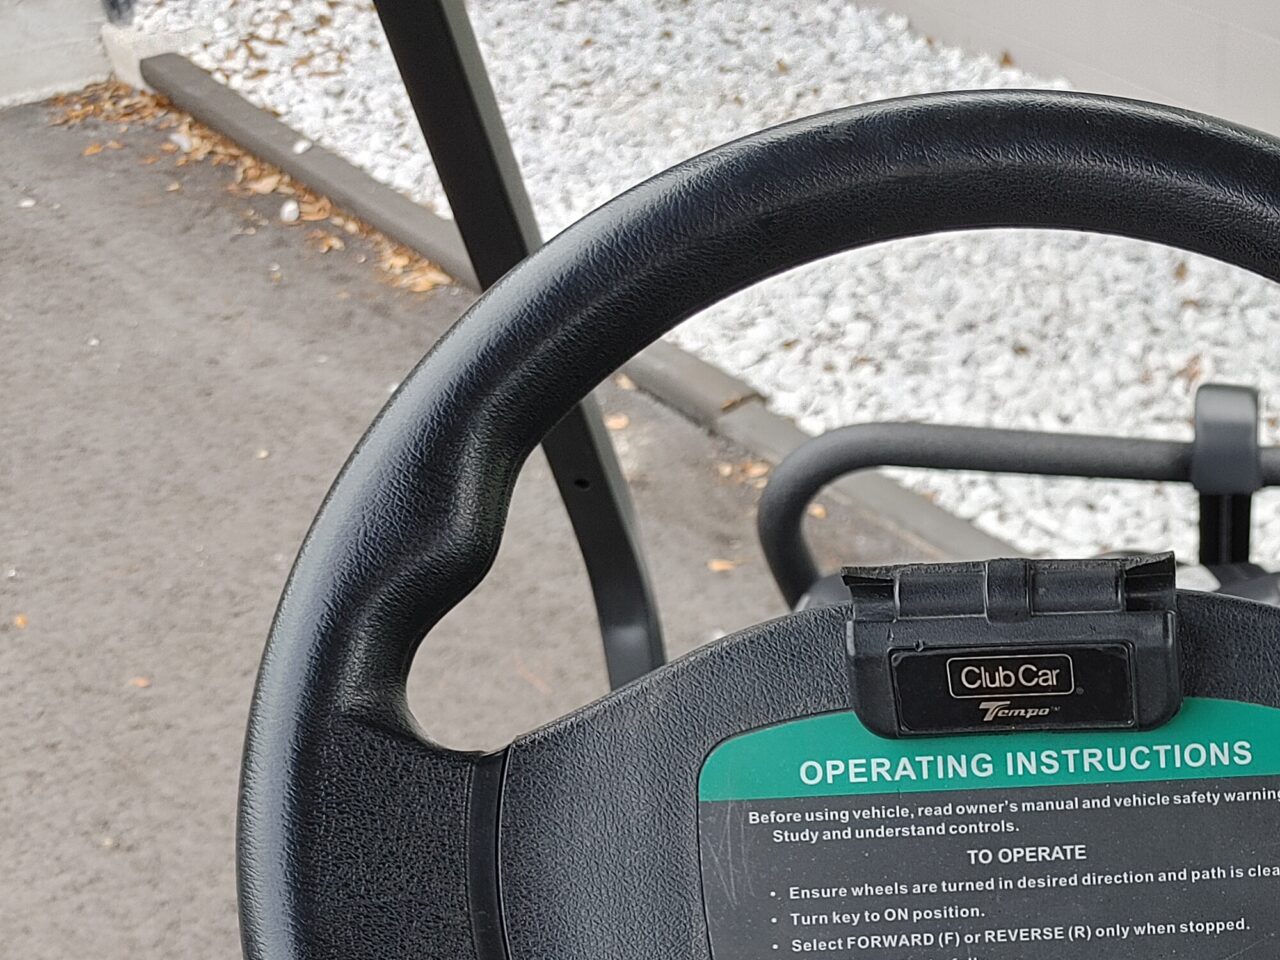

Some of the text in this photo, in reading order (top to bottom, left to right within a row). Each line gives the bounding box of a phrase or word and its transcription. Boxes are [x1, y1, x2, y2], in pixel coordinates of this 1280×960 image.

[961, 664, 1060, 689] Club Car
[799, 741, 1252, 785] OPERATING INSTRUCTIONS
[748, 810, 802, 824] Before
[805, 808, 850, 824] using
[852, 805, 915, 820] vehicle,
[918, 802, 953, 817] read
[956, 800, 1019, 815] owner's
[1021, 796, 1079, 812] manual
[1082, 795, 1111, 809] and
[1114, 792, 1170, 807] vehicle
[1173, 791, 1221, 806] safety
[772, 820, 1019, 844] Study and understand controls.
[966, 844, 1087, 865] TO OPERATE
[789, 886, 848, 899] Ensure
[850, 882, 908, 897] wheels
[912, 883, 938, 894] are
[941, 877, 995, 893] turned
[998, 877, 1013, 889] in
[1017, 873, 1078, 889] desired
[1081, 871, 1154, 886] direction
[1158, 868, 1187, 882] and
[1191, 866, 1226, 883] path
[1230, 865, 1244, 878] is
[789, 905, 985, 926] Turn key to ON position.
[792, 917, 1250, 952] Select FORWARD (F) or REVERSE (R) only when stopped.
